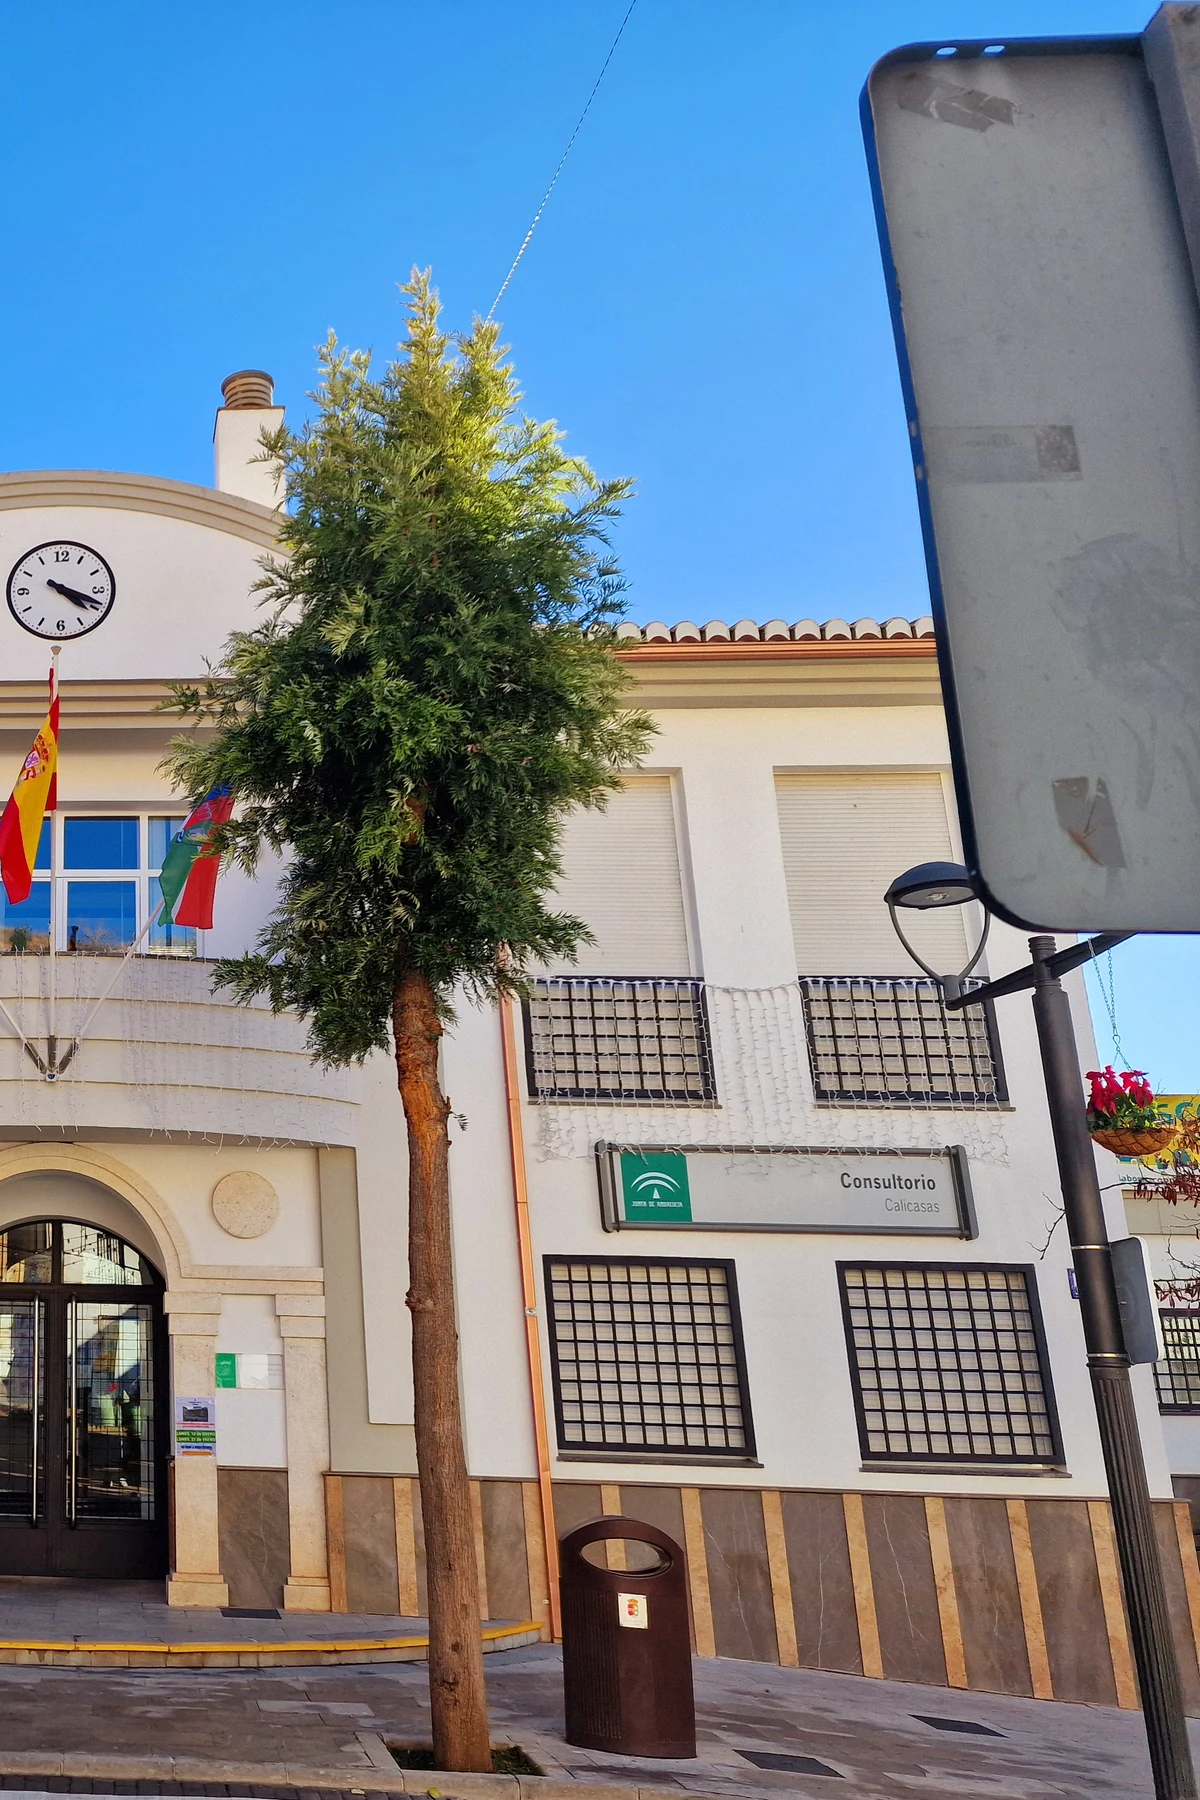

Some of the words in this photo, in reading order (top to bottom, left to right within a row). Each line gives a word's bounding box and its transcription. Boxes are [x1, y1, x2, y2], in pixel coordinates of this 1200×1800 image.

[54, 550, 70, 563] 12
[16, 588, 30, 596] 9
[92, 586, 105, 594] 3
[56, 620, 66, 631] 6
[840, 1172, 936, 1190] Consultorio
[884, 1197, 940, 1213] Calicasas
